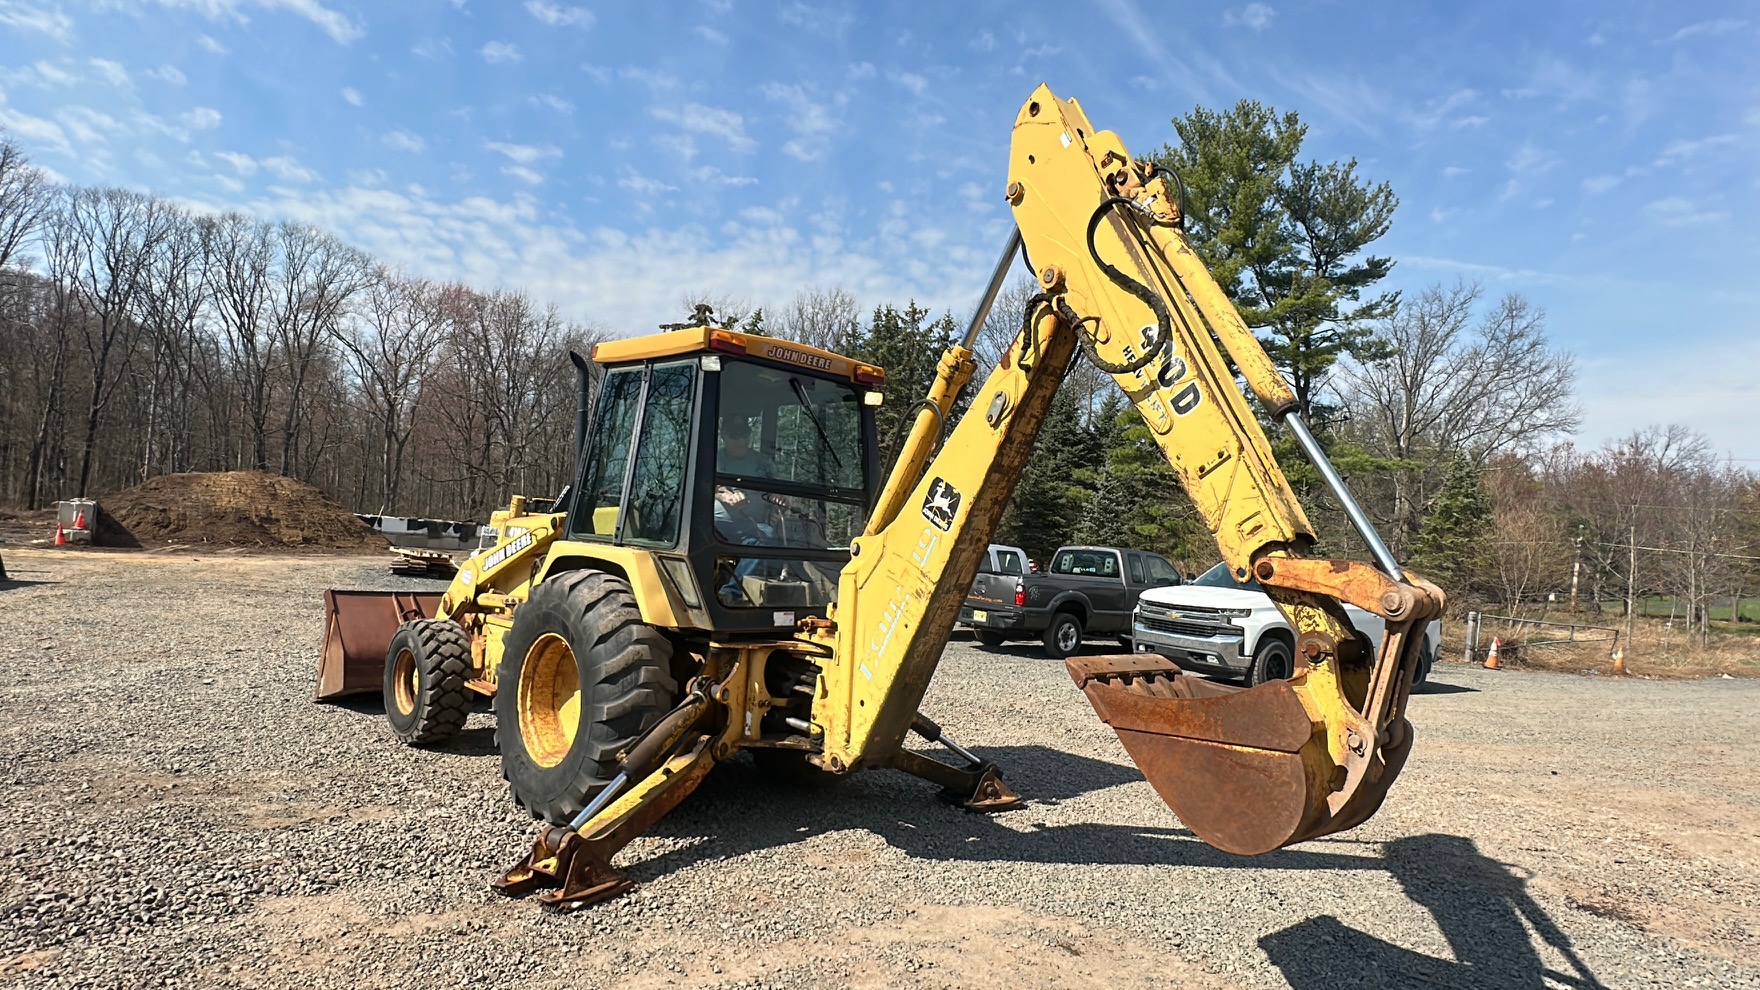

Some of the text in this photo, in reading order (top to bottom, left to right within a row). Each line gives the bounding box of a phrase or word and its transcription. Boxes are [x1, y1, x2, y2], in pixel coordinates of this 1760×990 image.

[768, 346, 832, 370] JOHN DEERE
[482, 546, 506, 571] JOHN
[505, 532, 533, 558] DEERE
